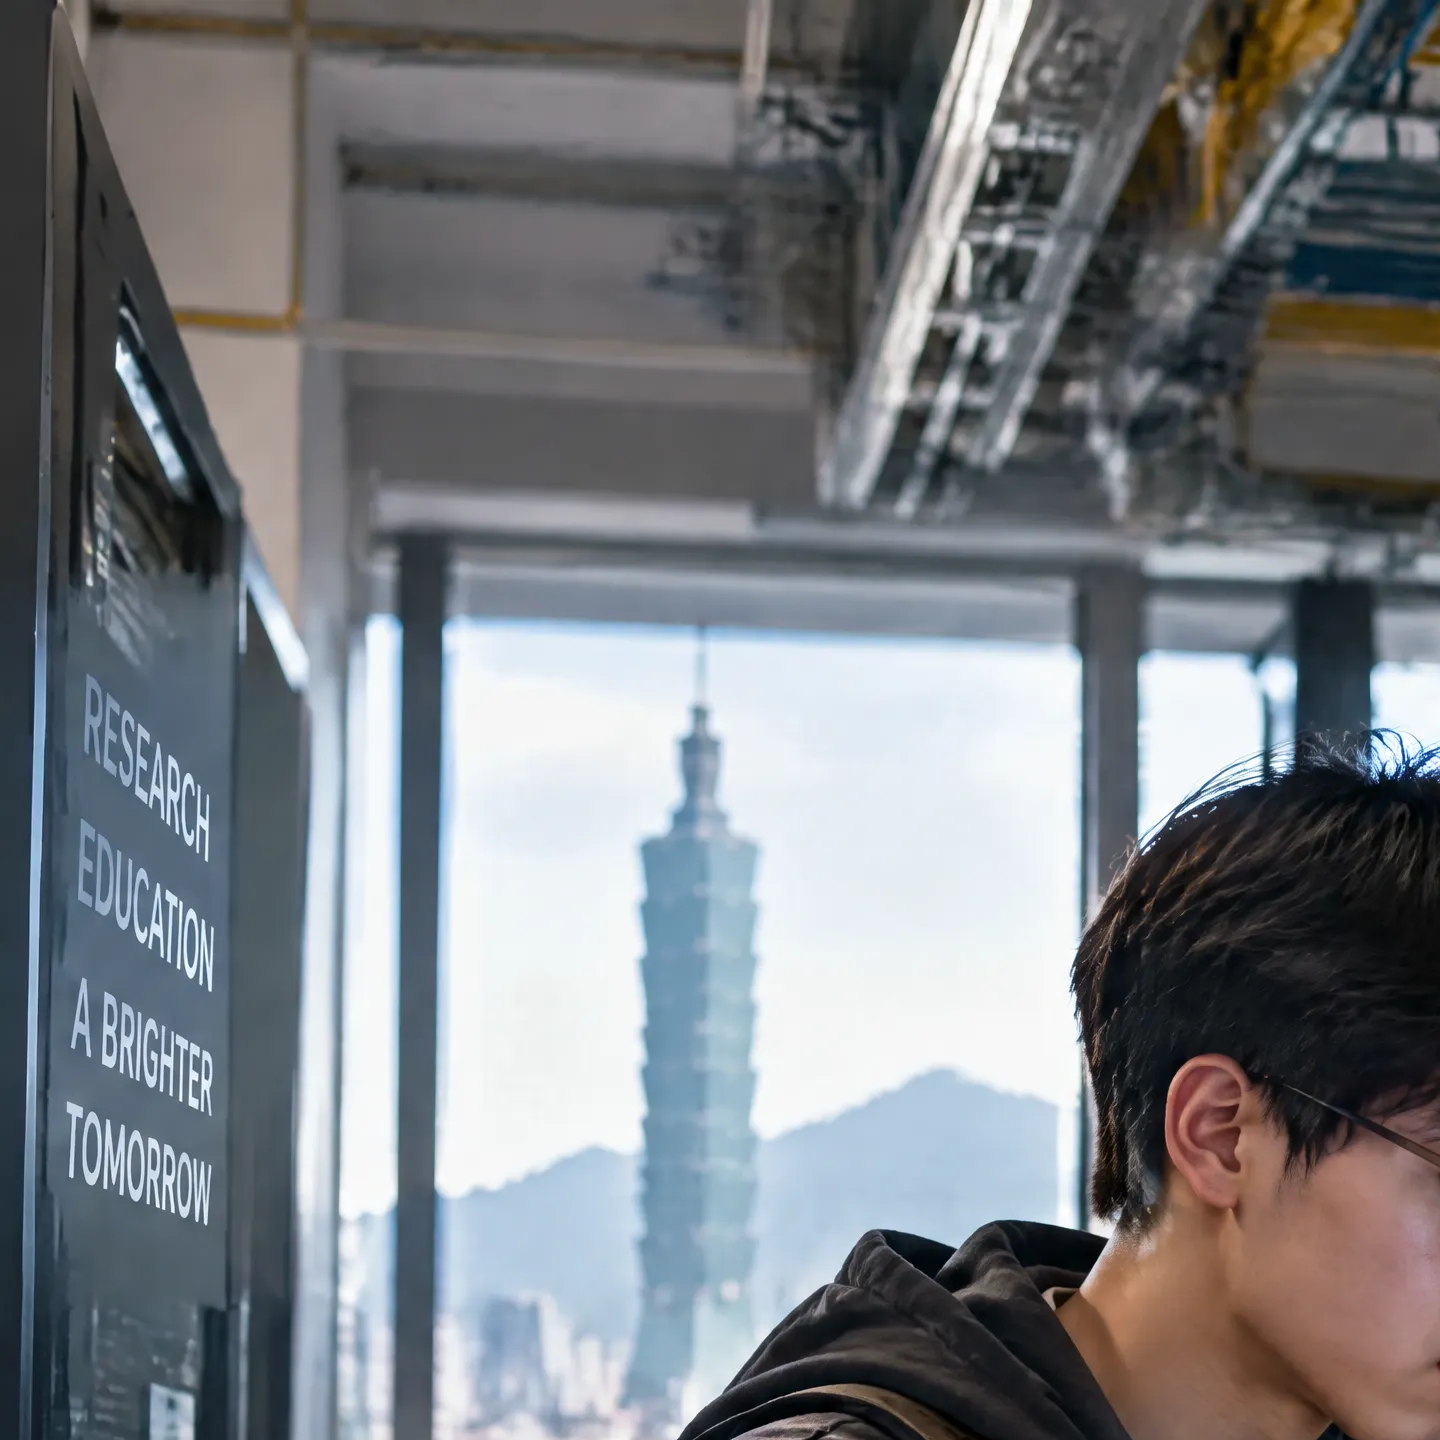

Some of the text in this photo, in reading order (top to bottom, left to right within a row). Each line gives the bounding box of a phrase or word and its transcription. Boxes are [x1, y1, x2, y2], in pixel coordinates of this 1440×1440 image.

[83, 673, 210, 862] RESEARCH
[77, 817, 214, 993] EDUCATION
[71, 977, 213, 1117] A BRIGHTER
[66, 1101, 212, 1226] TOMORROW
